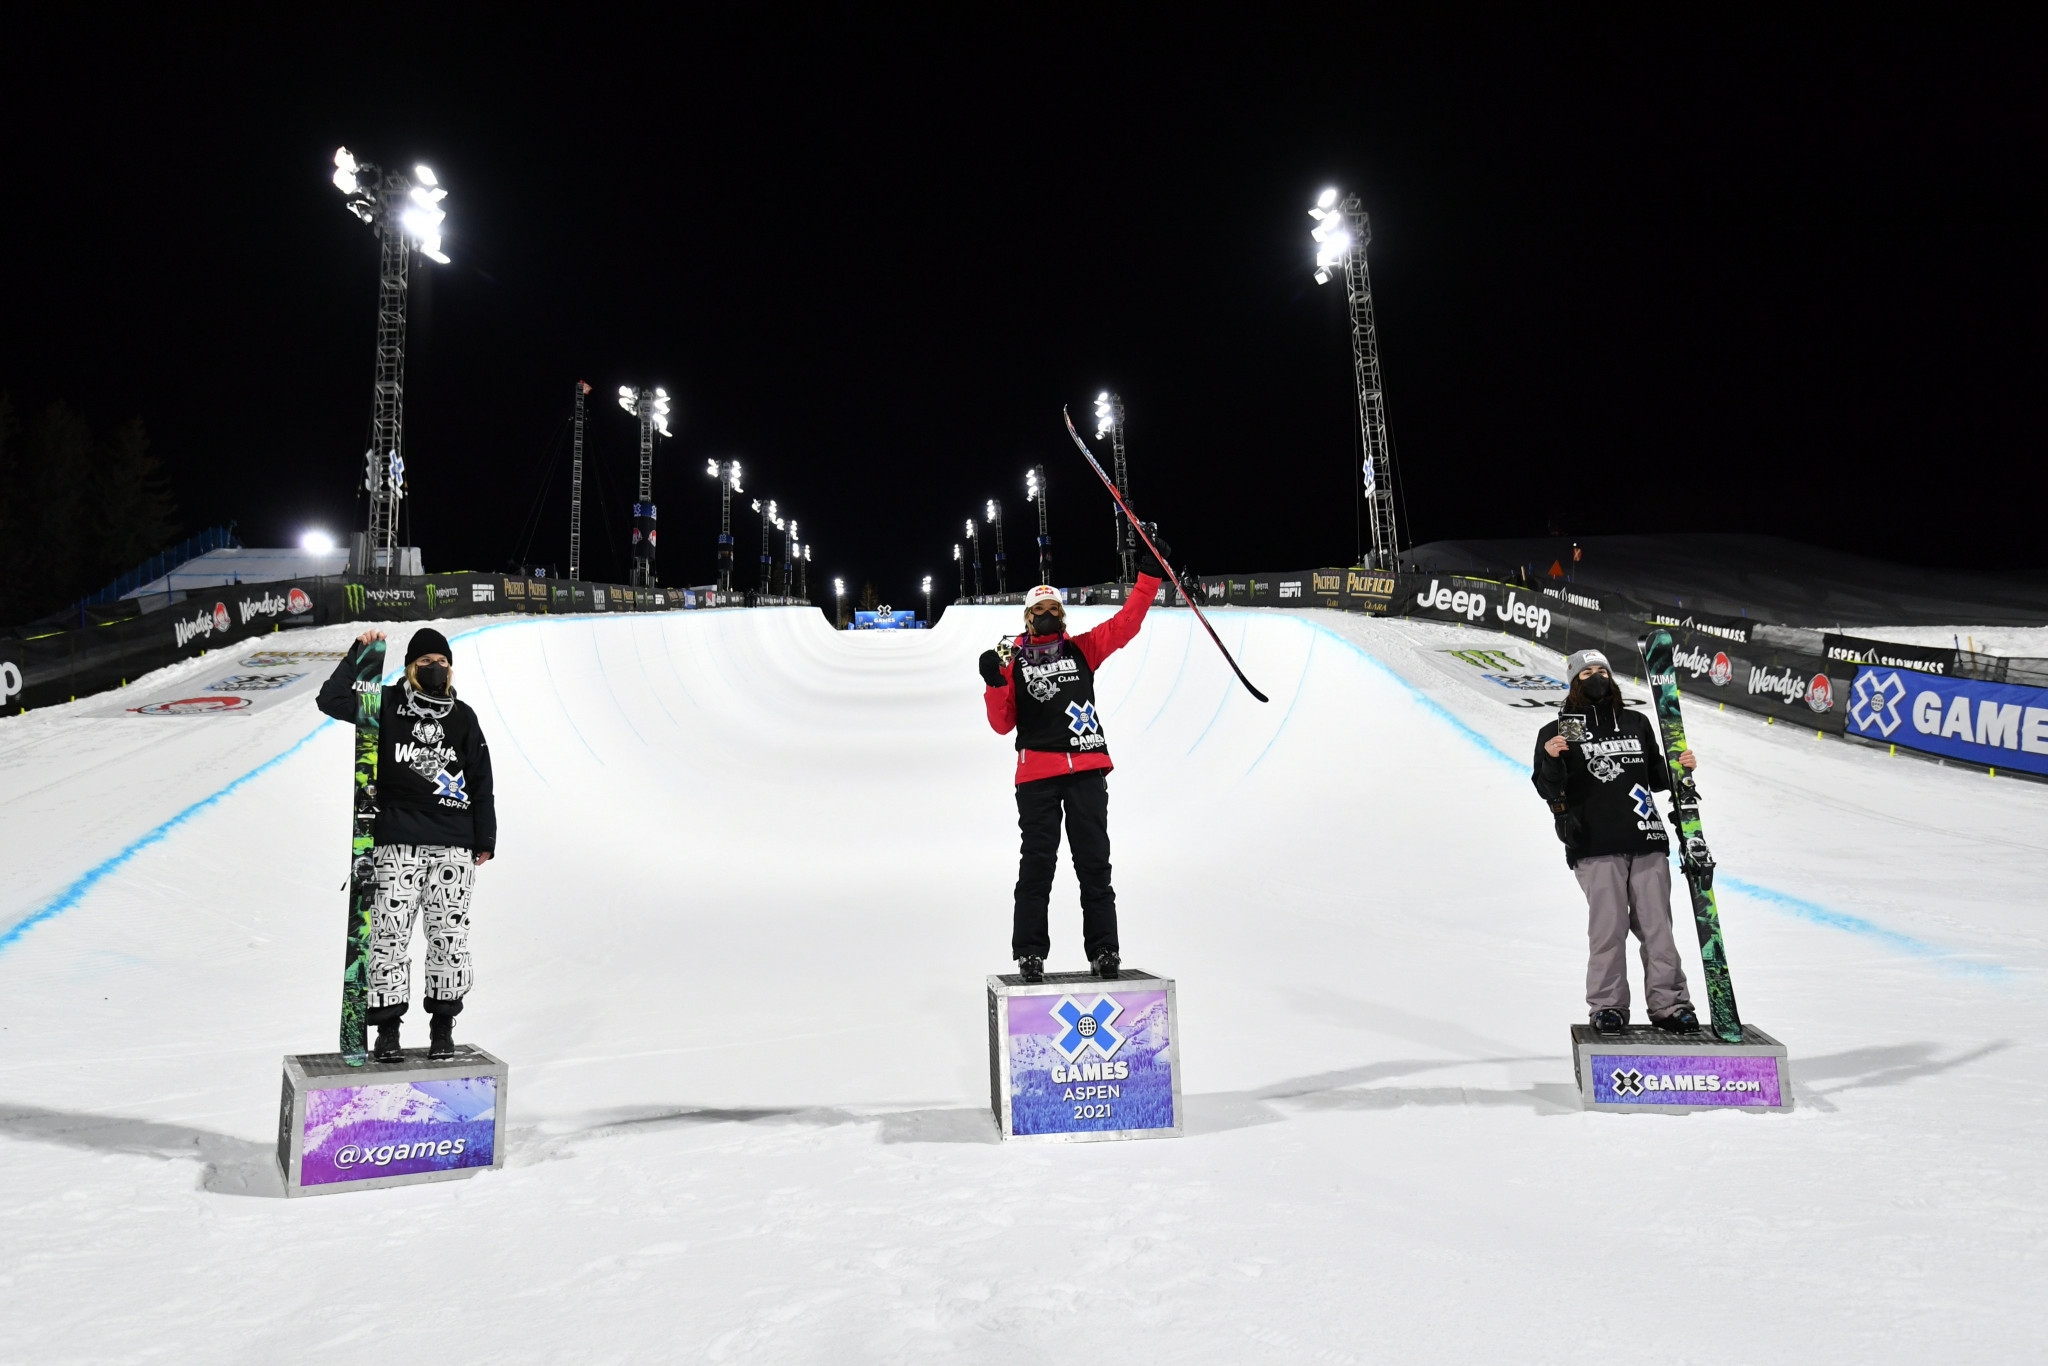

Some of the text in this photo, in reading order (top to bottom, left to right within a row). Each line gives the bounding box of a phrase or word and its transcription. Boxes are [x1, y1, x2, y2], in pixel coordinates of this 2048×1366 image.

[1279, 581, 1302, 598] ESPN
[1312, 572, 1340, 592] PACIFICO
[1346, 572, 1395, 595] PACIFICO
[366, 588, 416, 601] MONSTER
[472, 583, 495, 602] ESPN
[1416, 579, 1487, 620] Jeep
[239, 591, 286, 624] Wendy's
[1364, 600, 1388, 612] CLARA
[1496, 591, 1551, 638] Jeep
[174, 609, 214, 648] Wendy's
[1656, 615, 1680, 627] ASPEN
[1827, 647, 1861, 662] ASPEN
[1021, 658, 1077, 684] PACIFICO
[1058, 675, 1080, 683] CLARA
[1651, 674, 1676, 686] ZUMA
[356, 680, 381, 693] ZUMA
[1747, 666, 1806, 704] Wendy's
[1508, 698, 1648, 708] Jep
[1580, 739, 1642, 760] PACIFICO
[1621, 756, 1644, 764] CLARA
[1051, 1061, 1129, 1084] GAMES
[1063, 1084, 1121, 1101] ASPEN
[1073, 1103, 1113, 1121] 2021
[334, 1138, 466, 1170] @xgames
